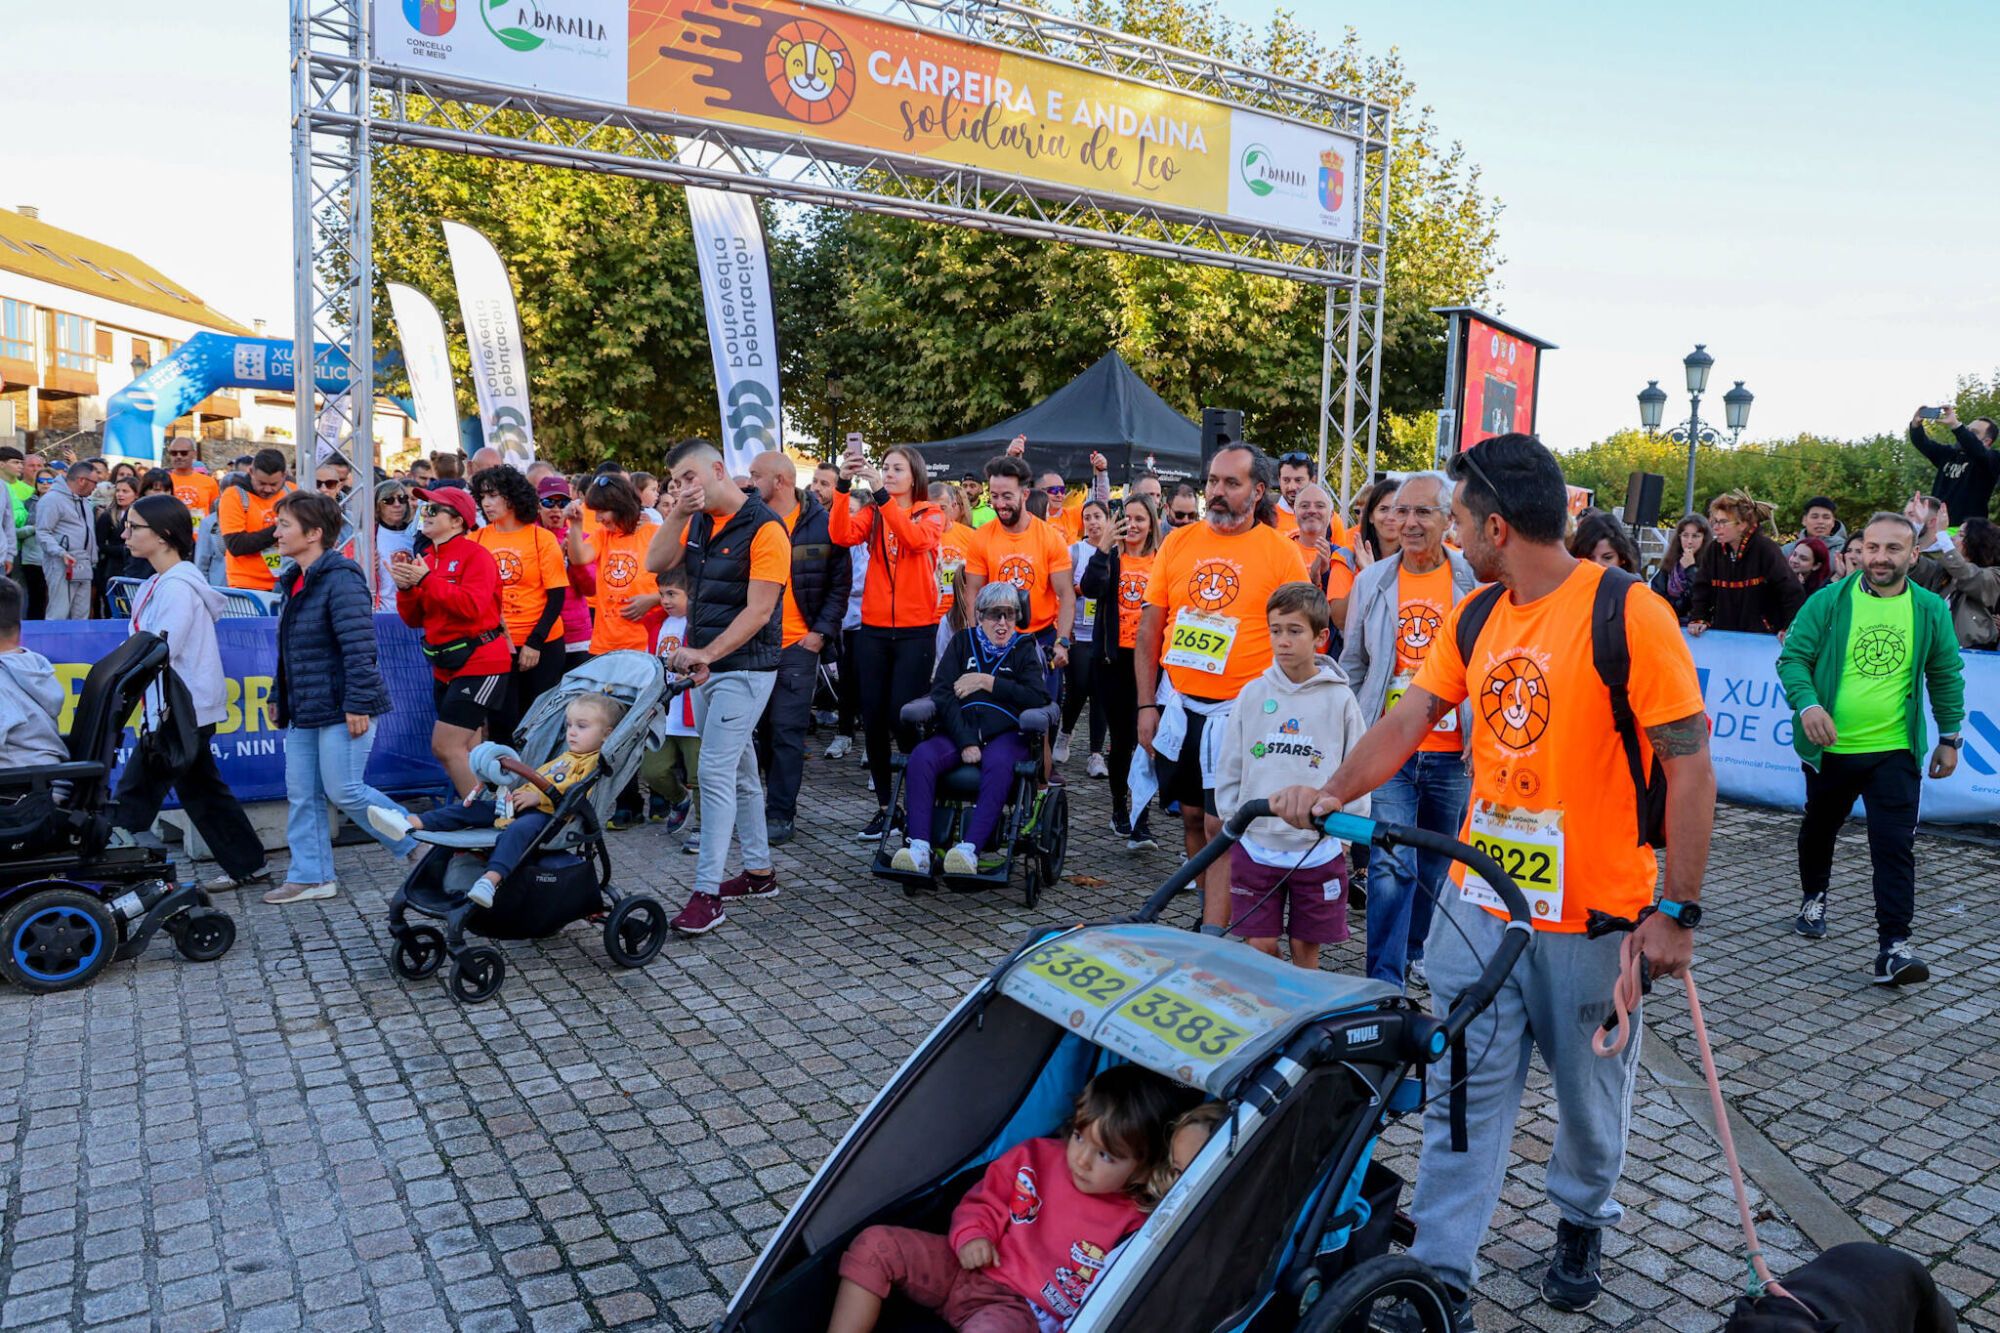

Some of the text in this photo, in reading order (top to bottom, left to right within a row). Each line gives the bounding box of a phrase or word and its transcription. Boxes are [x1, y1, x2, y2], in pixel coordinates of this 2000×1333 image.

[518, 8, 608, 41] A BARALLA
[406, 38, 453, 53] CONCELLO
[412, 47, 447, 60] DE MEIS
[867, 50, 1208, 153] CARREIRA E ANDAINA
[900, 86, 1182, 191] solidaria de Leo
[271, 362, 293, 377] DE
[1173, 628, 1226, 654] 2657
[1713, 712, 1760, 743] DE
[236, 738, 276, 757] NIN
[1266, 742, 1313, 757] STARS
[1725, 756, 1763, 768] Provincial
[1764, 760, 1801, 774] Deportes
[1029, 945, 1126, 1001] 3382
[1131, 992, 1241, 1056] 3383
[1346, 1024, 1379, 1045] THULE
